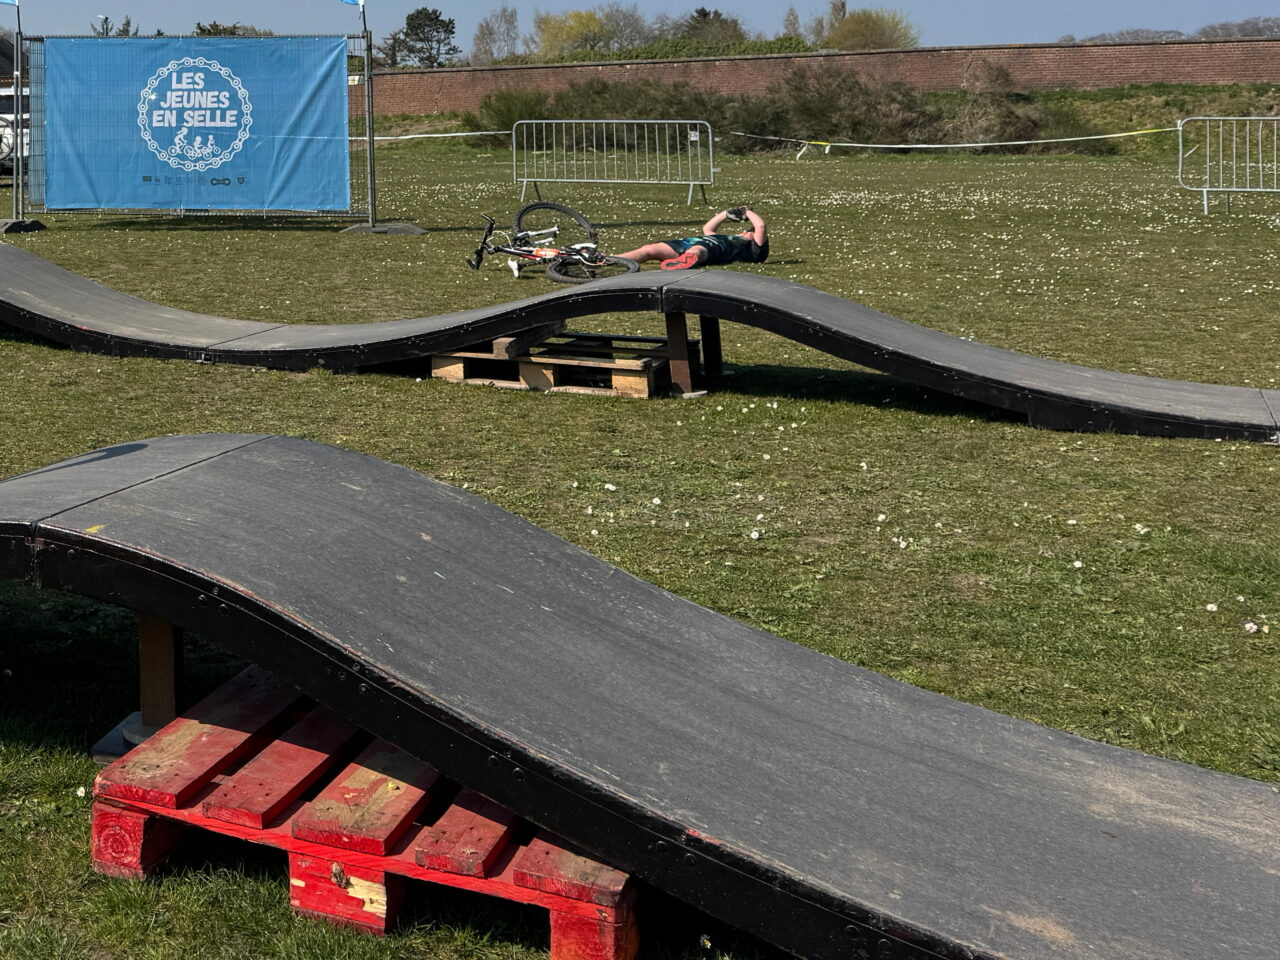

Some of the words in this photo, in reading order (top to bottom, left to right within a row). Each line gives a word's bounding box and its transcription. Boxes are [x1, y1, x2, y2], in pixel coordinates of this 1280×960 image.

[171, 72, 205, 89] LES
[160, 91, 230, 108] JEUNES
[152, 110, 177, 127] EN
[183, 110, 238, 127] SELLE
